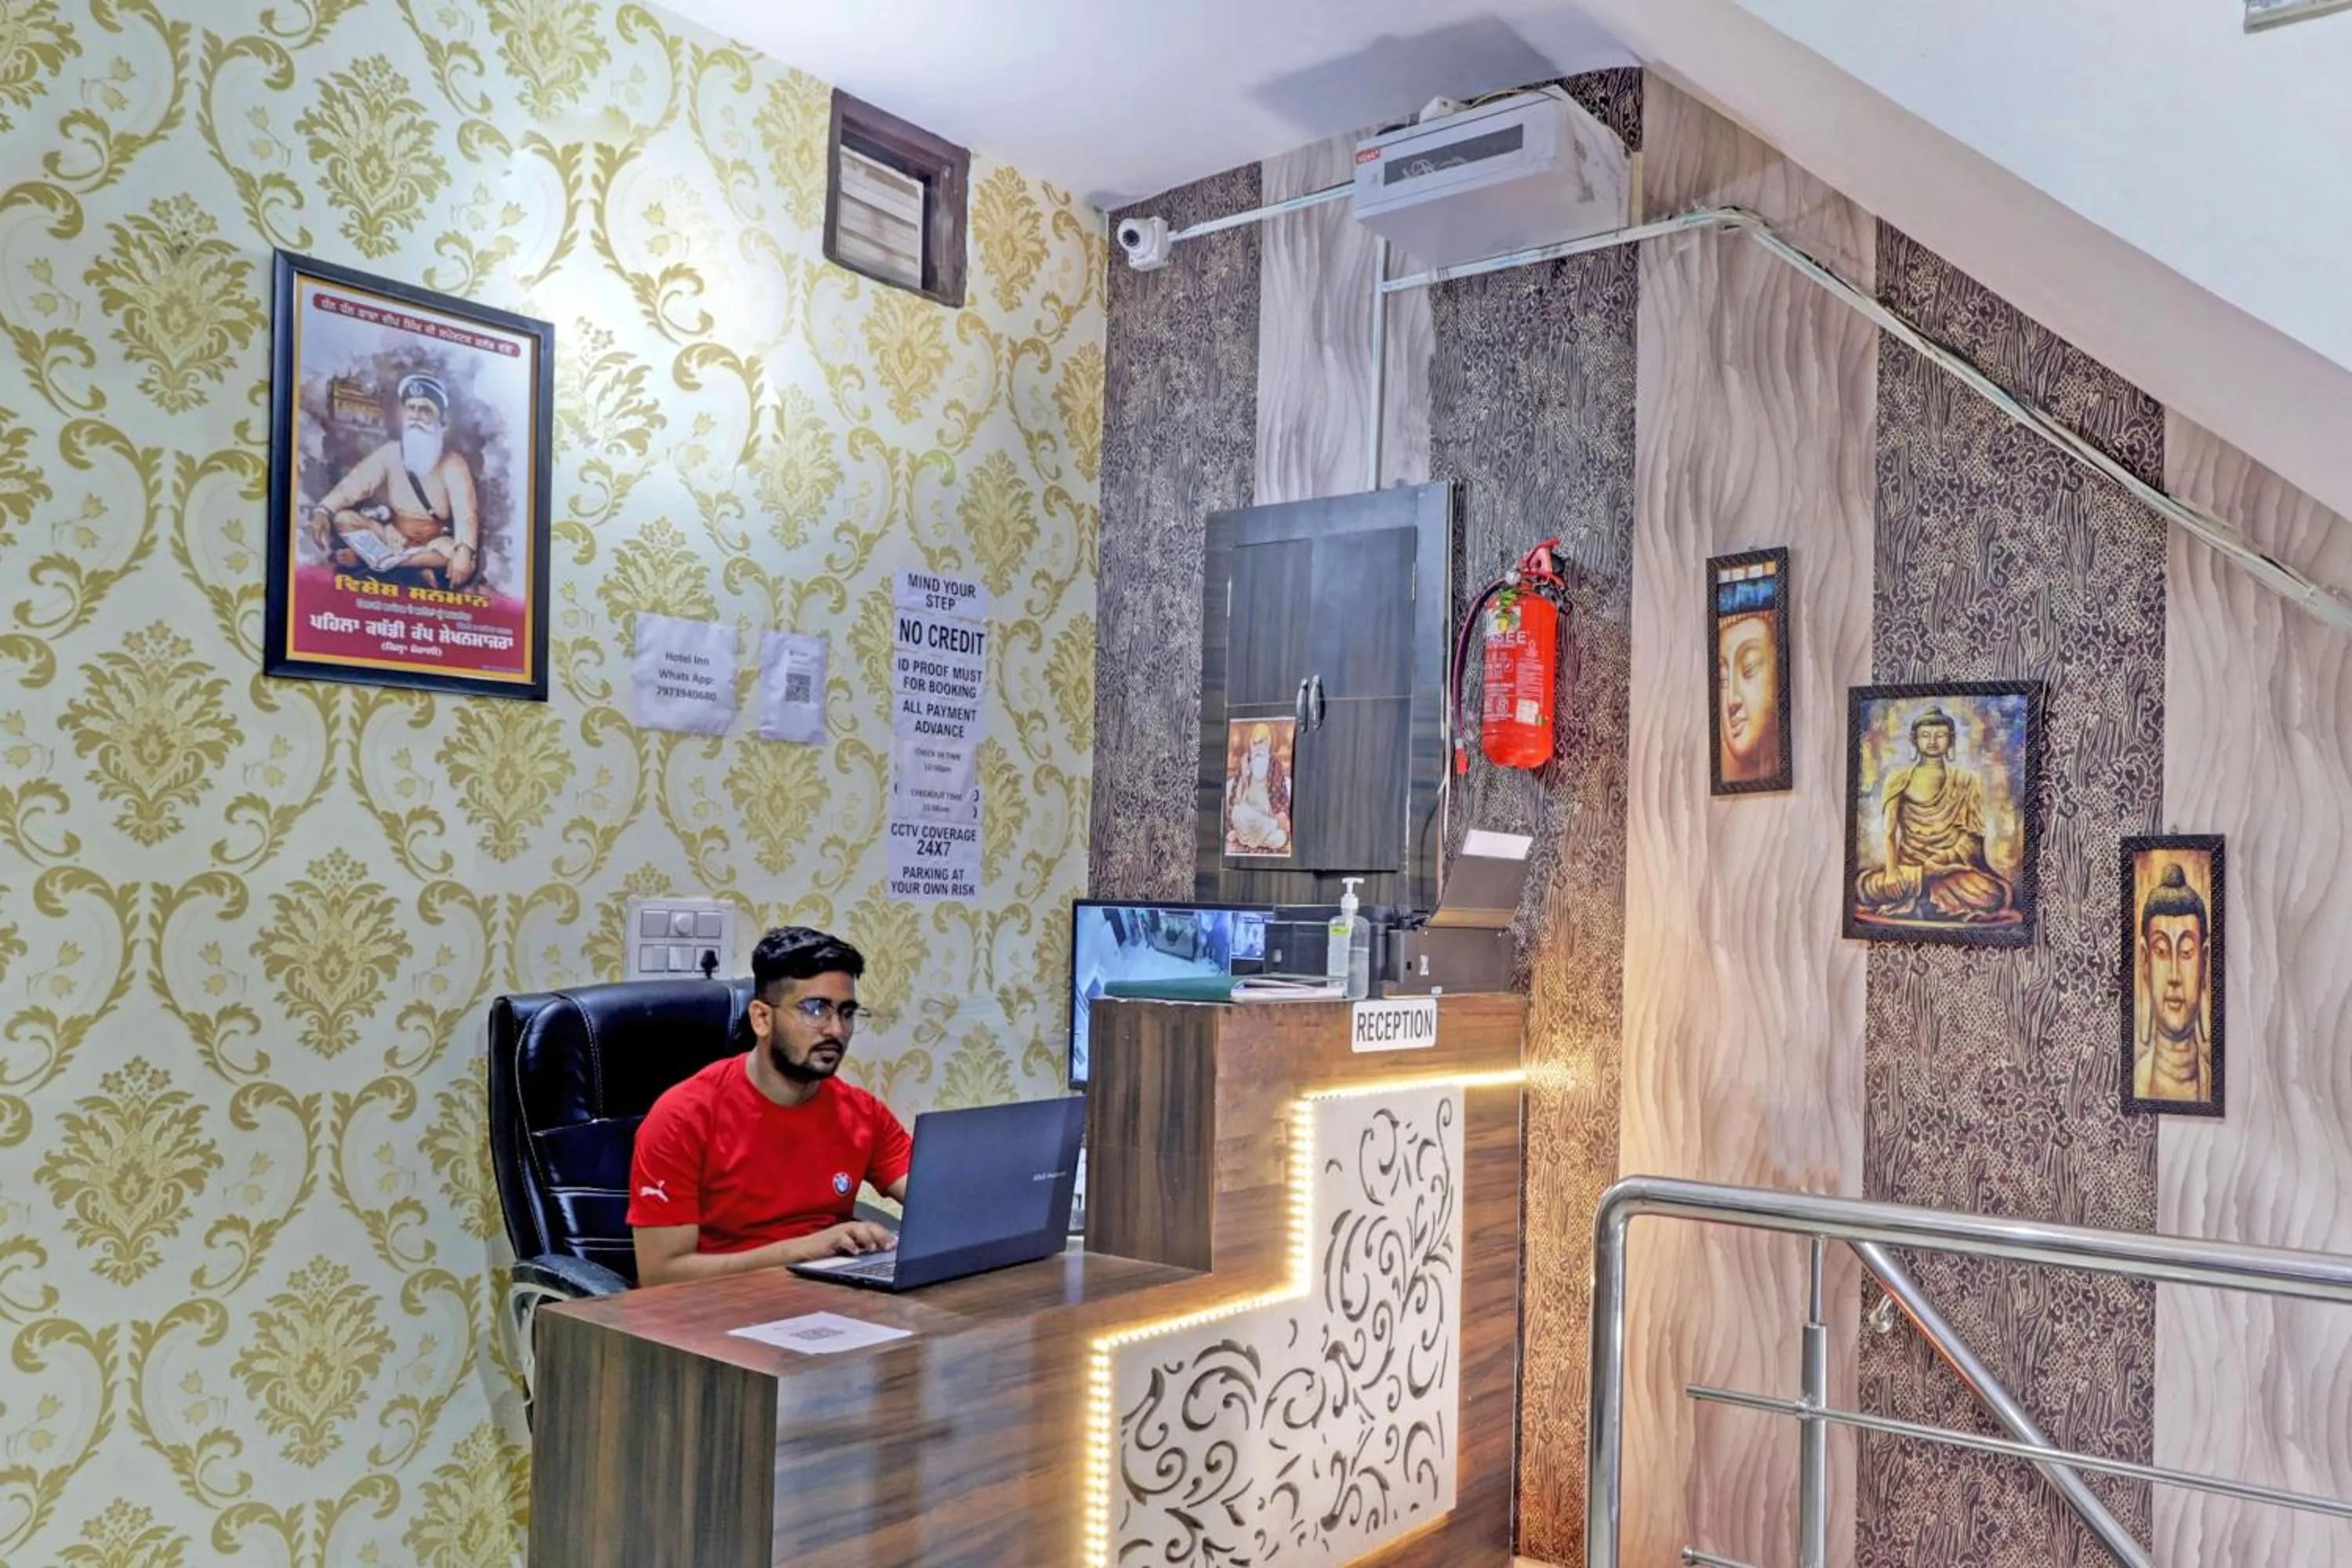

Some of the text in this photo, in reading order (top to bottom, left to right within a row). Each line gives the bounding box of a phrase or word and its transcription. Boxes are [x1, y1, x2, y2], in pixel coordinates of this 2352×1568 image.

[908, 573, 976, 598] MIND YOUR
[926, 593, 956, 611] STEP
[309, 612, 360, 633] ਪਹਿਲਾ
[365, 619, 405, 639] ਕਬੱਡੀ
[899, 618, 985, 655] NO CREDIT
[665, 652, 710, 666] Hotel Inn
[898, 658, 982, 684] ID PROOF MUST
[903, 677, 976, 699] FOR BOOKING
[903, 700, 978, 722] ALL PAYMENT
[915, 720, 964, 738] ADVANCE
[891, 823, 977, 842] CCTV COVERAGE
[916, 840, 952, 857] 24X7
[902, 866, 965, 881] PARKING AT
[891, 881, 975, 896] YOUR OWN RISK
[1356, 1009, 1433, 1043] RECEPTION
